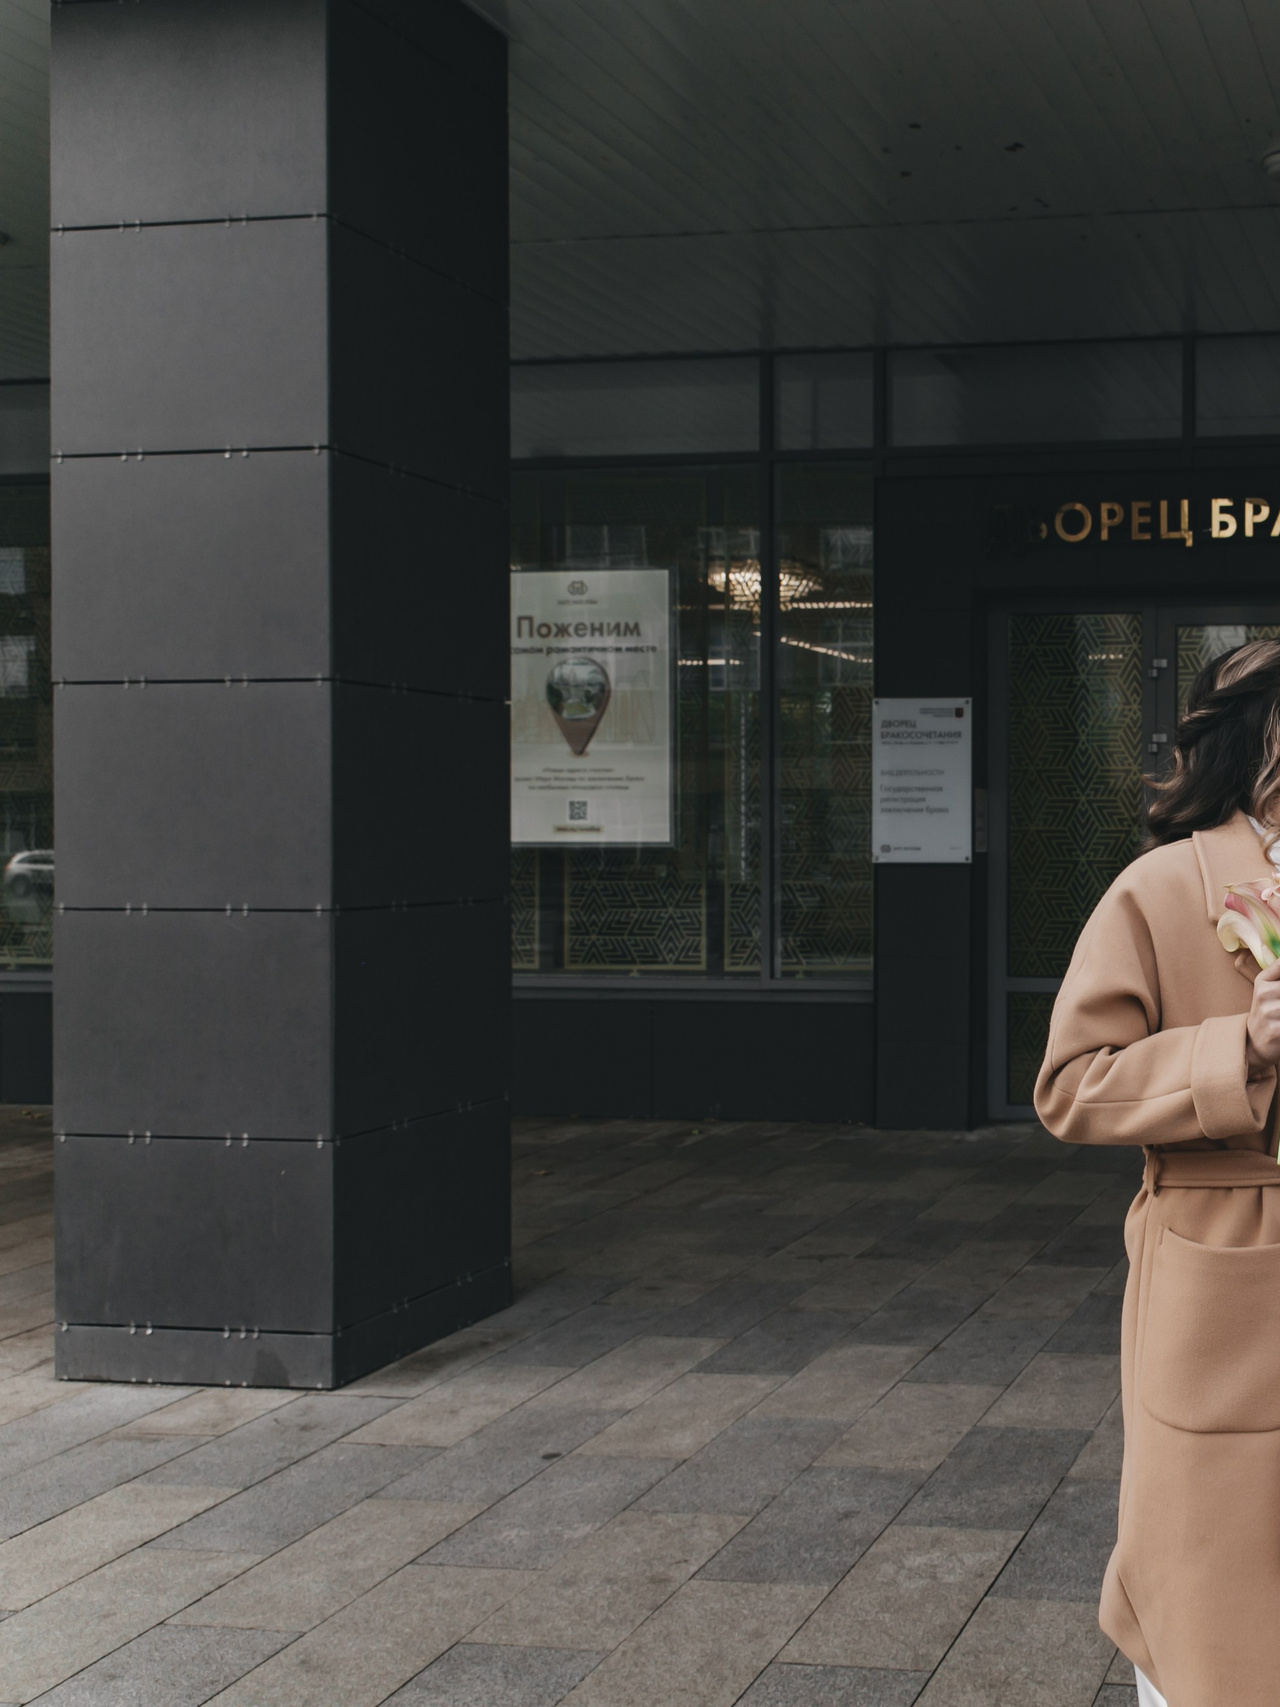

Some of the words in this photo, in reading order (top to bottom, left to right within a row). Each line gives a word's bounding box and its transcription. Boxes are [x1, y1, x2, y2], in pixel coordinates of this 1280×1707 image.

[992, 499, 1193, 547] ОРЕЦ
[516, 615, 641, 639] Поженим
[881, 720, 917, 729] ДВОРЕЦ
[880, 731, 962, 740] БРАКОСОЧЕТАНИЯ
